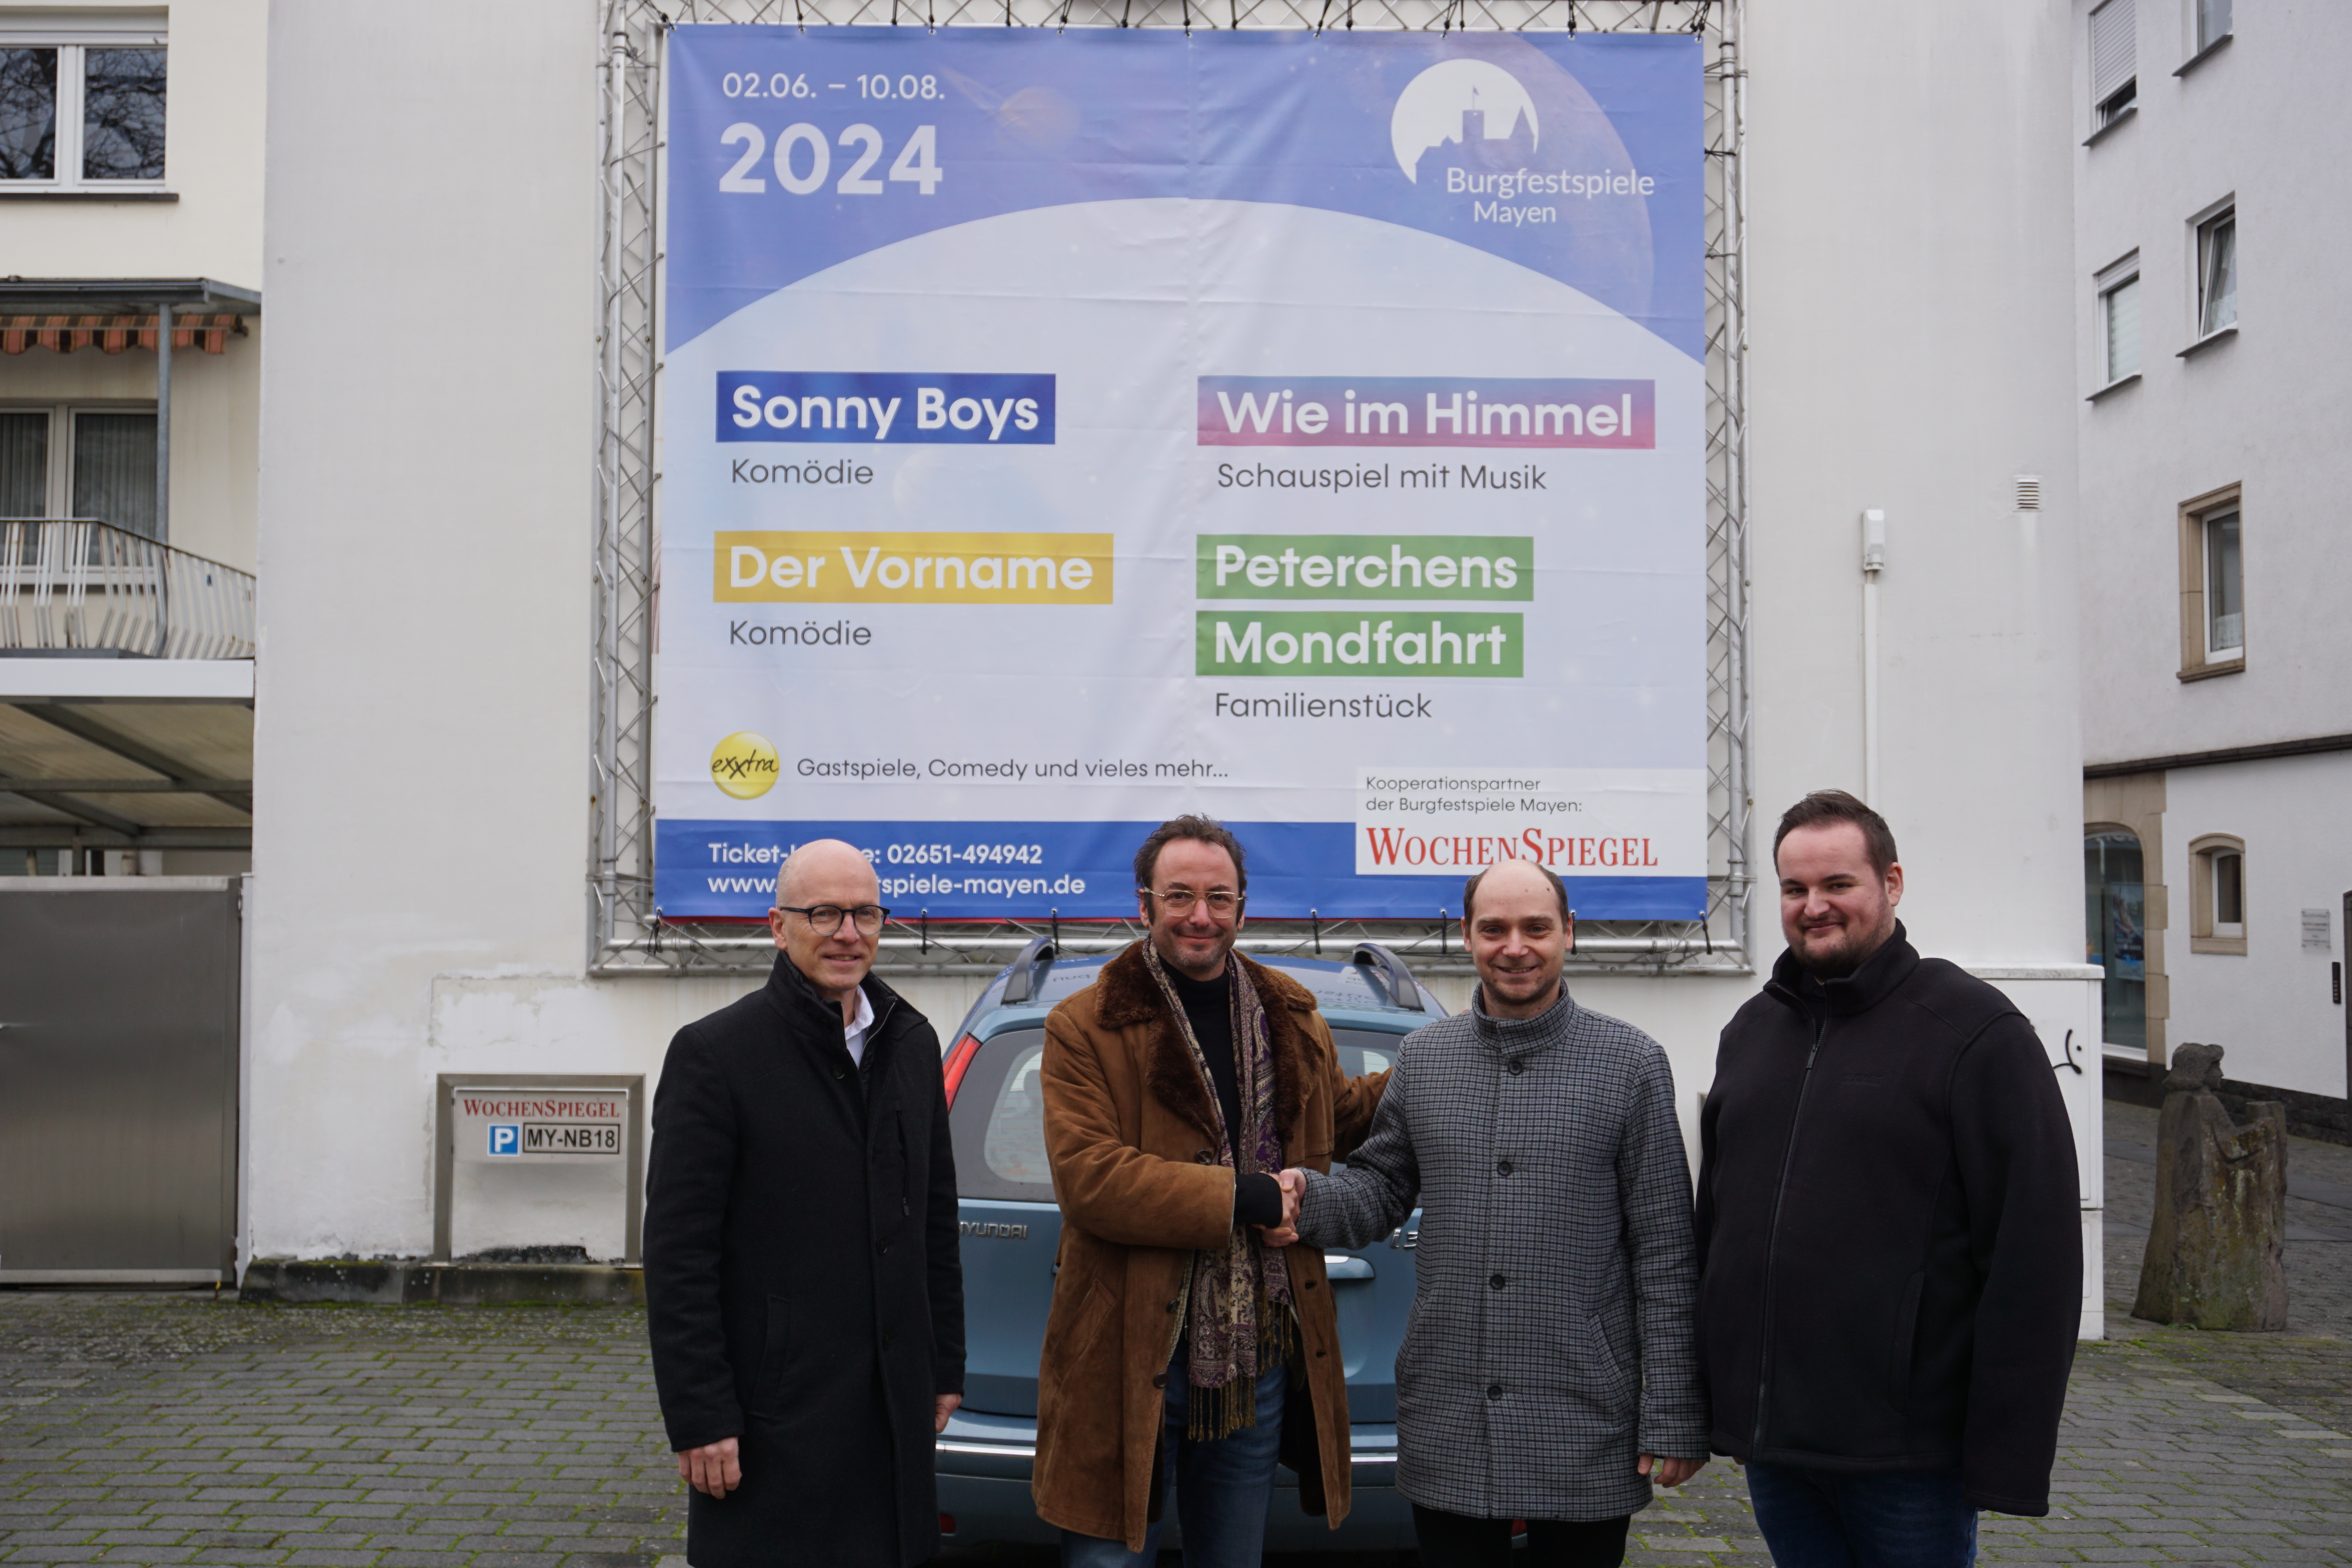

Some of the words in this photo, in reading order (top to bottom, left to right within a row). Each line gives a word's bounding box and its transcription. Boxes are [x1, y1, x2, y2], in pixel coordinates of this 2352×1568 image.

[723, 73, 816, 98] 02.06.
[857, 74, 944, 99] 10.08.
[719, 122, 943, 195] 2024
[1448, 167, 1654, 200] Burgfestspiele
[1475, 201, 1556, 227] Mayen
[733, 385, 900, 439] Sonny
[917, 388, 1038, 440] Boys
[1217, 389, 1328, 434] Wie
[1345, 389, 1408, 433] im
[1427, 390, 1631, 436] Himmel
[733, 459, 873, 484] Komödie
[1218, 463, 1388, 493] Schauspiel
[1401, 464, 1450, 487] mit
[1462, 465, 1546, 489] Musik
[731, 546, 826, 588] Der
[840, 546, 1093, 590] Vorname
[1216, 544, 1517, 588] Peterchens
[731, 621, 871, 645] Komödie
[1216, 621, 1506, 664] Mondfahrt
[1216, 693, 1431, 717] Familienstück
[711, 749, 779, 779] exxtra
[797, 759, 920, 780] Gastspiele,
[929, 759, 1027, 780] Comedy
[1036, 759, 1077, 777] und
[1085, 759, 1148, 777] vieles
[1156, 759, 1227, 777] mehr...
[1367, 777, 1540, 793] Kooperationspartner
[1366, 798, 1394, 810] der
[1400, 798, 1515, 814] Burgfestspiele
[1521, 799, 1582, 814] Mayen:
[887, 844, 1042, 864] 02651-494942
[495, 1128, 514, 1152] P
[528, 1129, 615, 1147] MY-NB18
